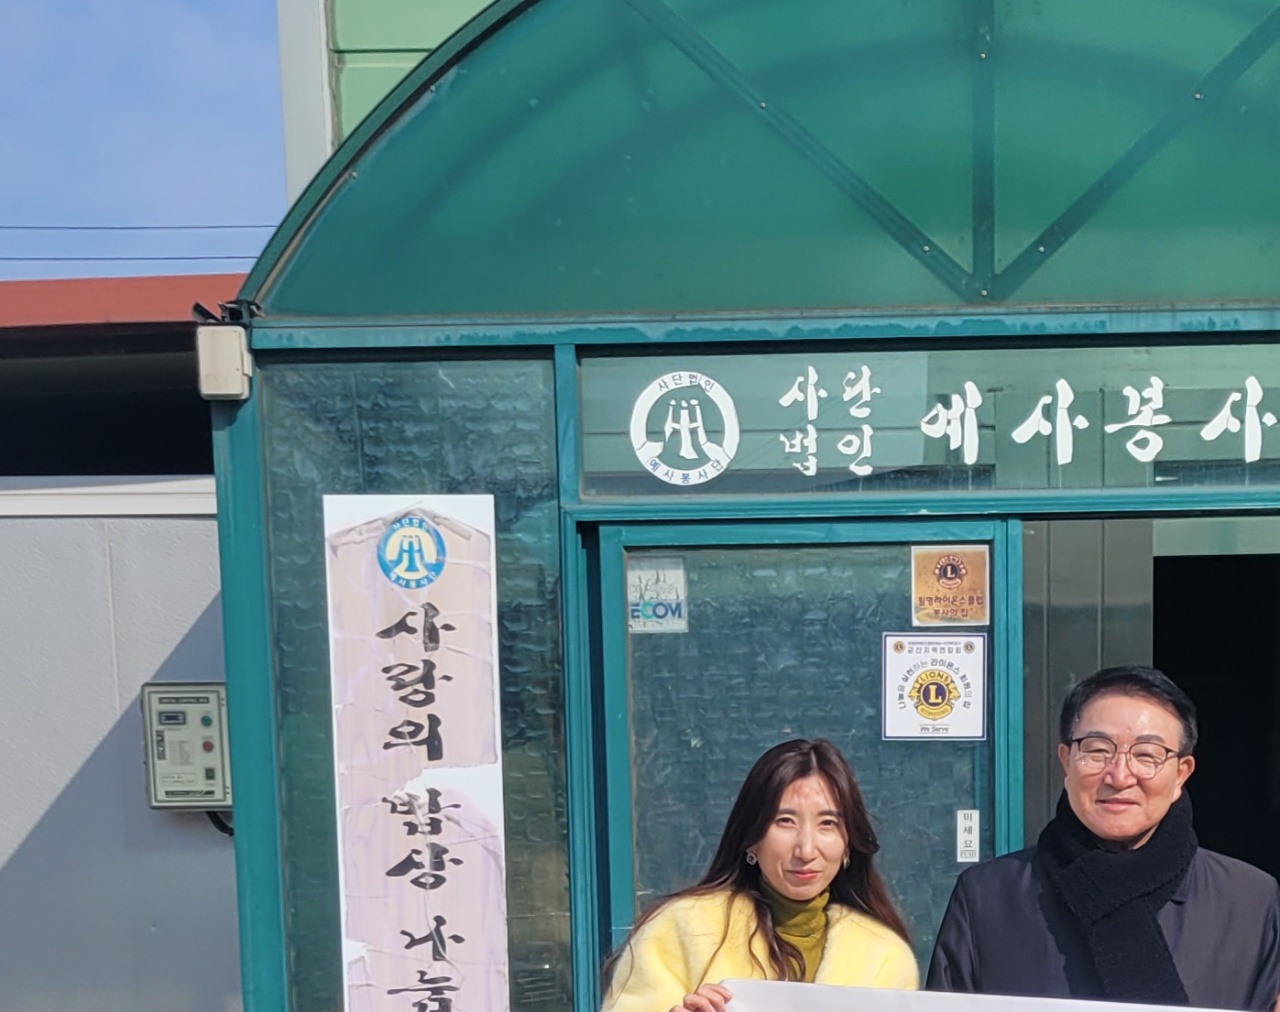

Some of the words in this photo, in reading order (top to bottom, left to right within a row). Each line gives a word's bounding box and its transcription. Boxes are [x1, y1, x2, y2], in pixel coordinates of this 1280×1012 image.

[376, 602, 457, 761] 사랑의
[919, 671, 950, 683] LIONS
[928, 684, 943, 703] L
[963, 812, 974, 849] 미세요
